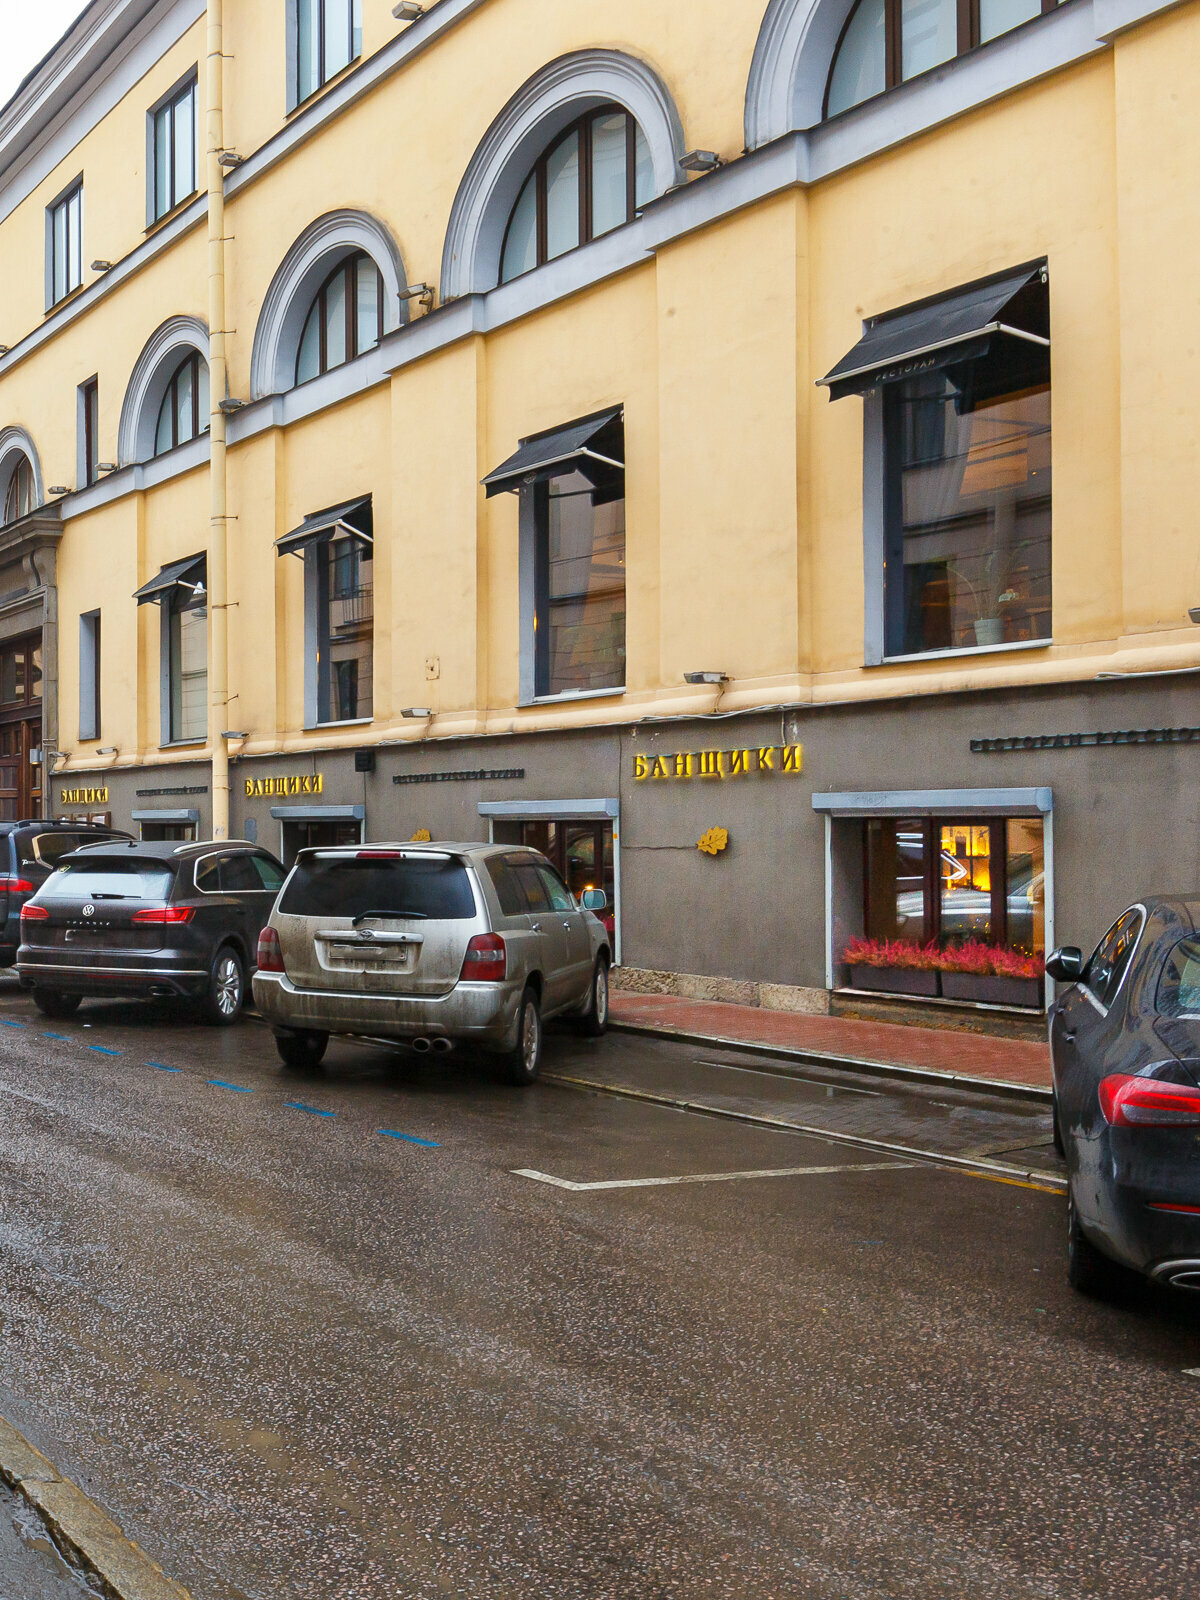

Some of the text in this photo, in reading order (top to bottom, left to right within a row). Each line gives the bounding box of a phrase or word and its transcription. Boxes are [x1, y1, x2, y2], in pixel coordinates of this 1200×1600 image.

[631, 745, 800, 779] БАНЩИКИ
[61, 786, 109, 804] БАНЩИКИ
[244, 774, 323, 797] БАНЩИКИ
